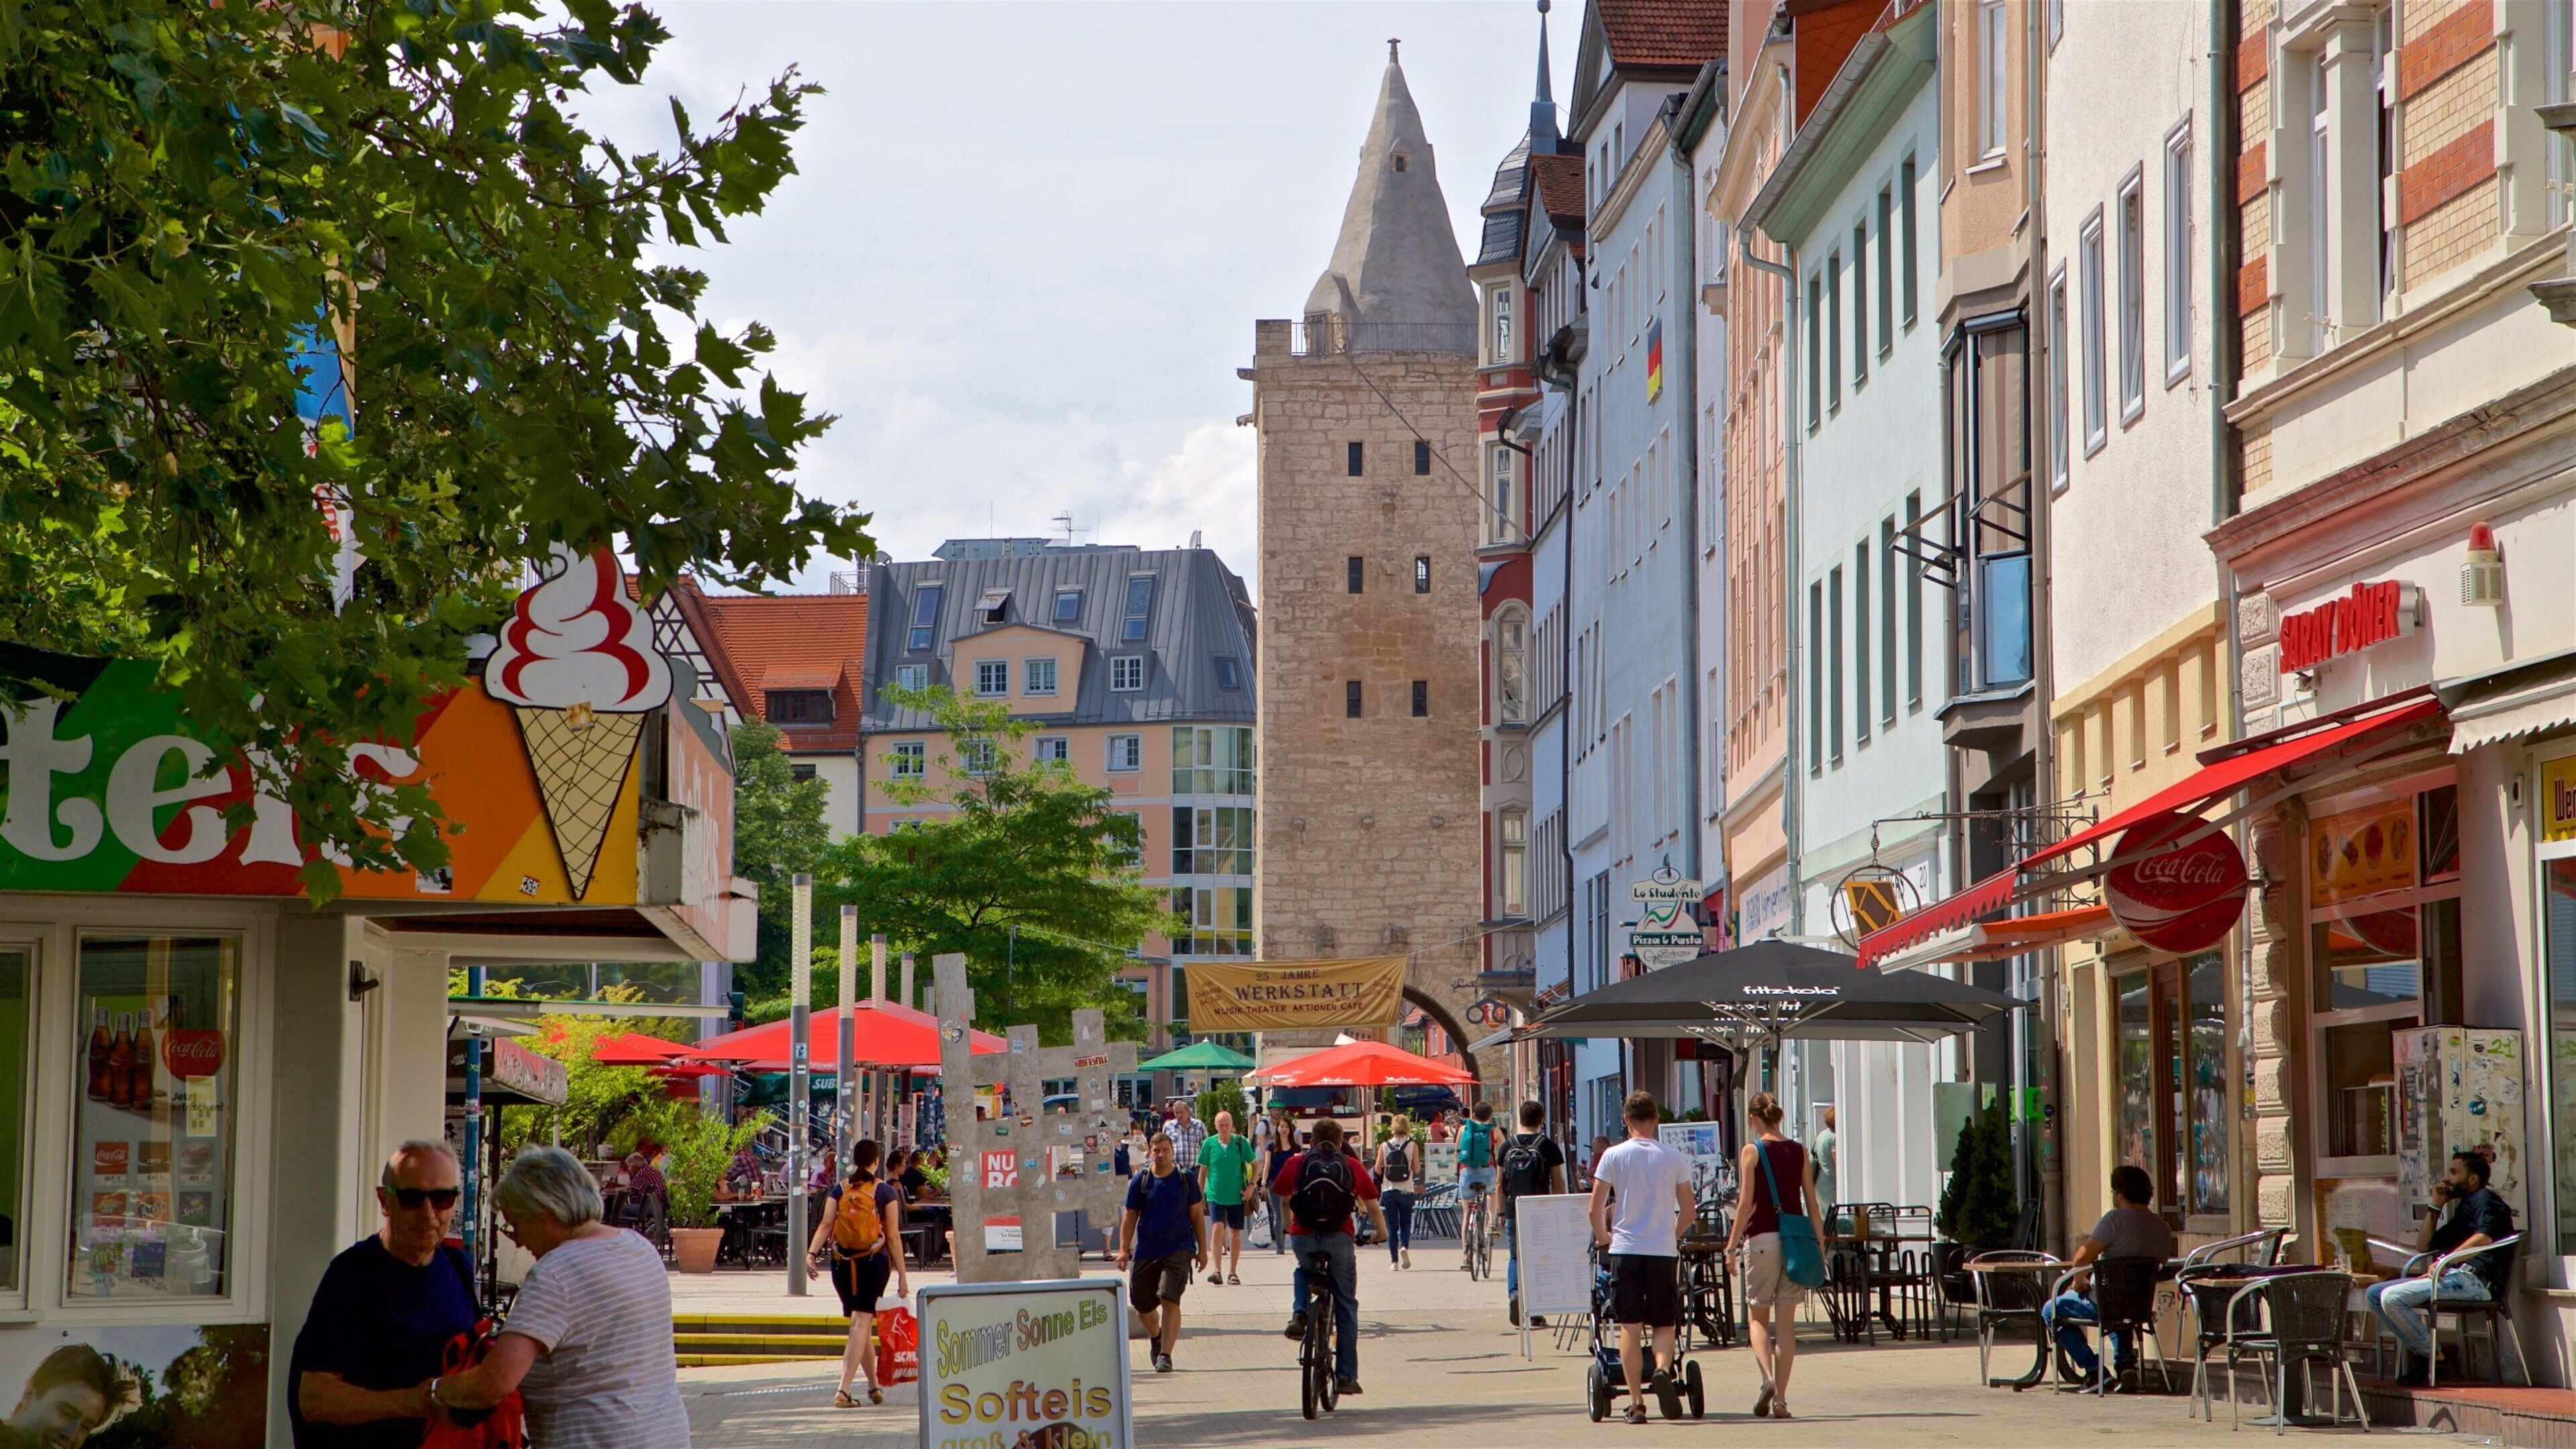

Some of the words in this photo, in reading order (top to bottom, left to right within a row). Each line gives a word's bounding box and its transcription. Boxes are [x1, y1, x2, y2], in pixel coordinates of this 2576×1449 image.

[2281, 600, 2337, 674] SARAY
[2337, 580, 2400, 655] DÖNER
[522, 876, 539, 888] FCK
[520, 885, 537, 896] NZS
[1650, 888, 1701, 898] Studente
[1633, 935, 1660, 945] Pizza
[1662, 935, 1668, 945] &
[1671, 935, 1702, 945] Pasta
[1256, 973, 1269, 981] 25
[1281, 969, 1320, 980] JAHRE
[1234, 982, 1364, 1001] WERKSTATT
[1743, 986, 1839, 995] fritz-kola
[1215, 1006, 1243, 1015] MUSIK
[1246, 1005, 1287, 1013] THEATER
[1293, 1004, 1337, 1012] AKTIONEN
[165, 1039, 219, 1058] Coca-Cola
[2487, 1038, 2516, 1059] 21
[812, 1078, 838, 1089] SUB
[172, 1093, 197, 1102] Jetzt
[97, 1150, 125, 1161] Coca-Cola
[937, 1319, 1012, 1379] Sommer
[1016, 1309, 1074, 1351] Sonne
[1079, 1300, 1108, 1330] Eis
[940, 1379, 1112, 1425] Softeis
